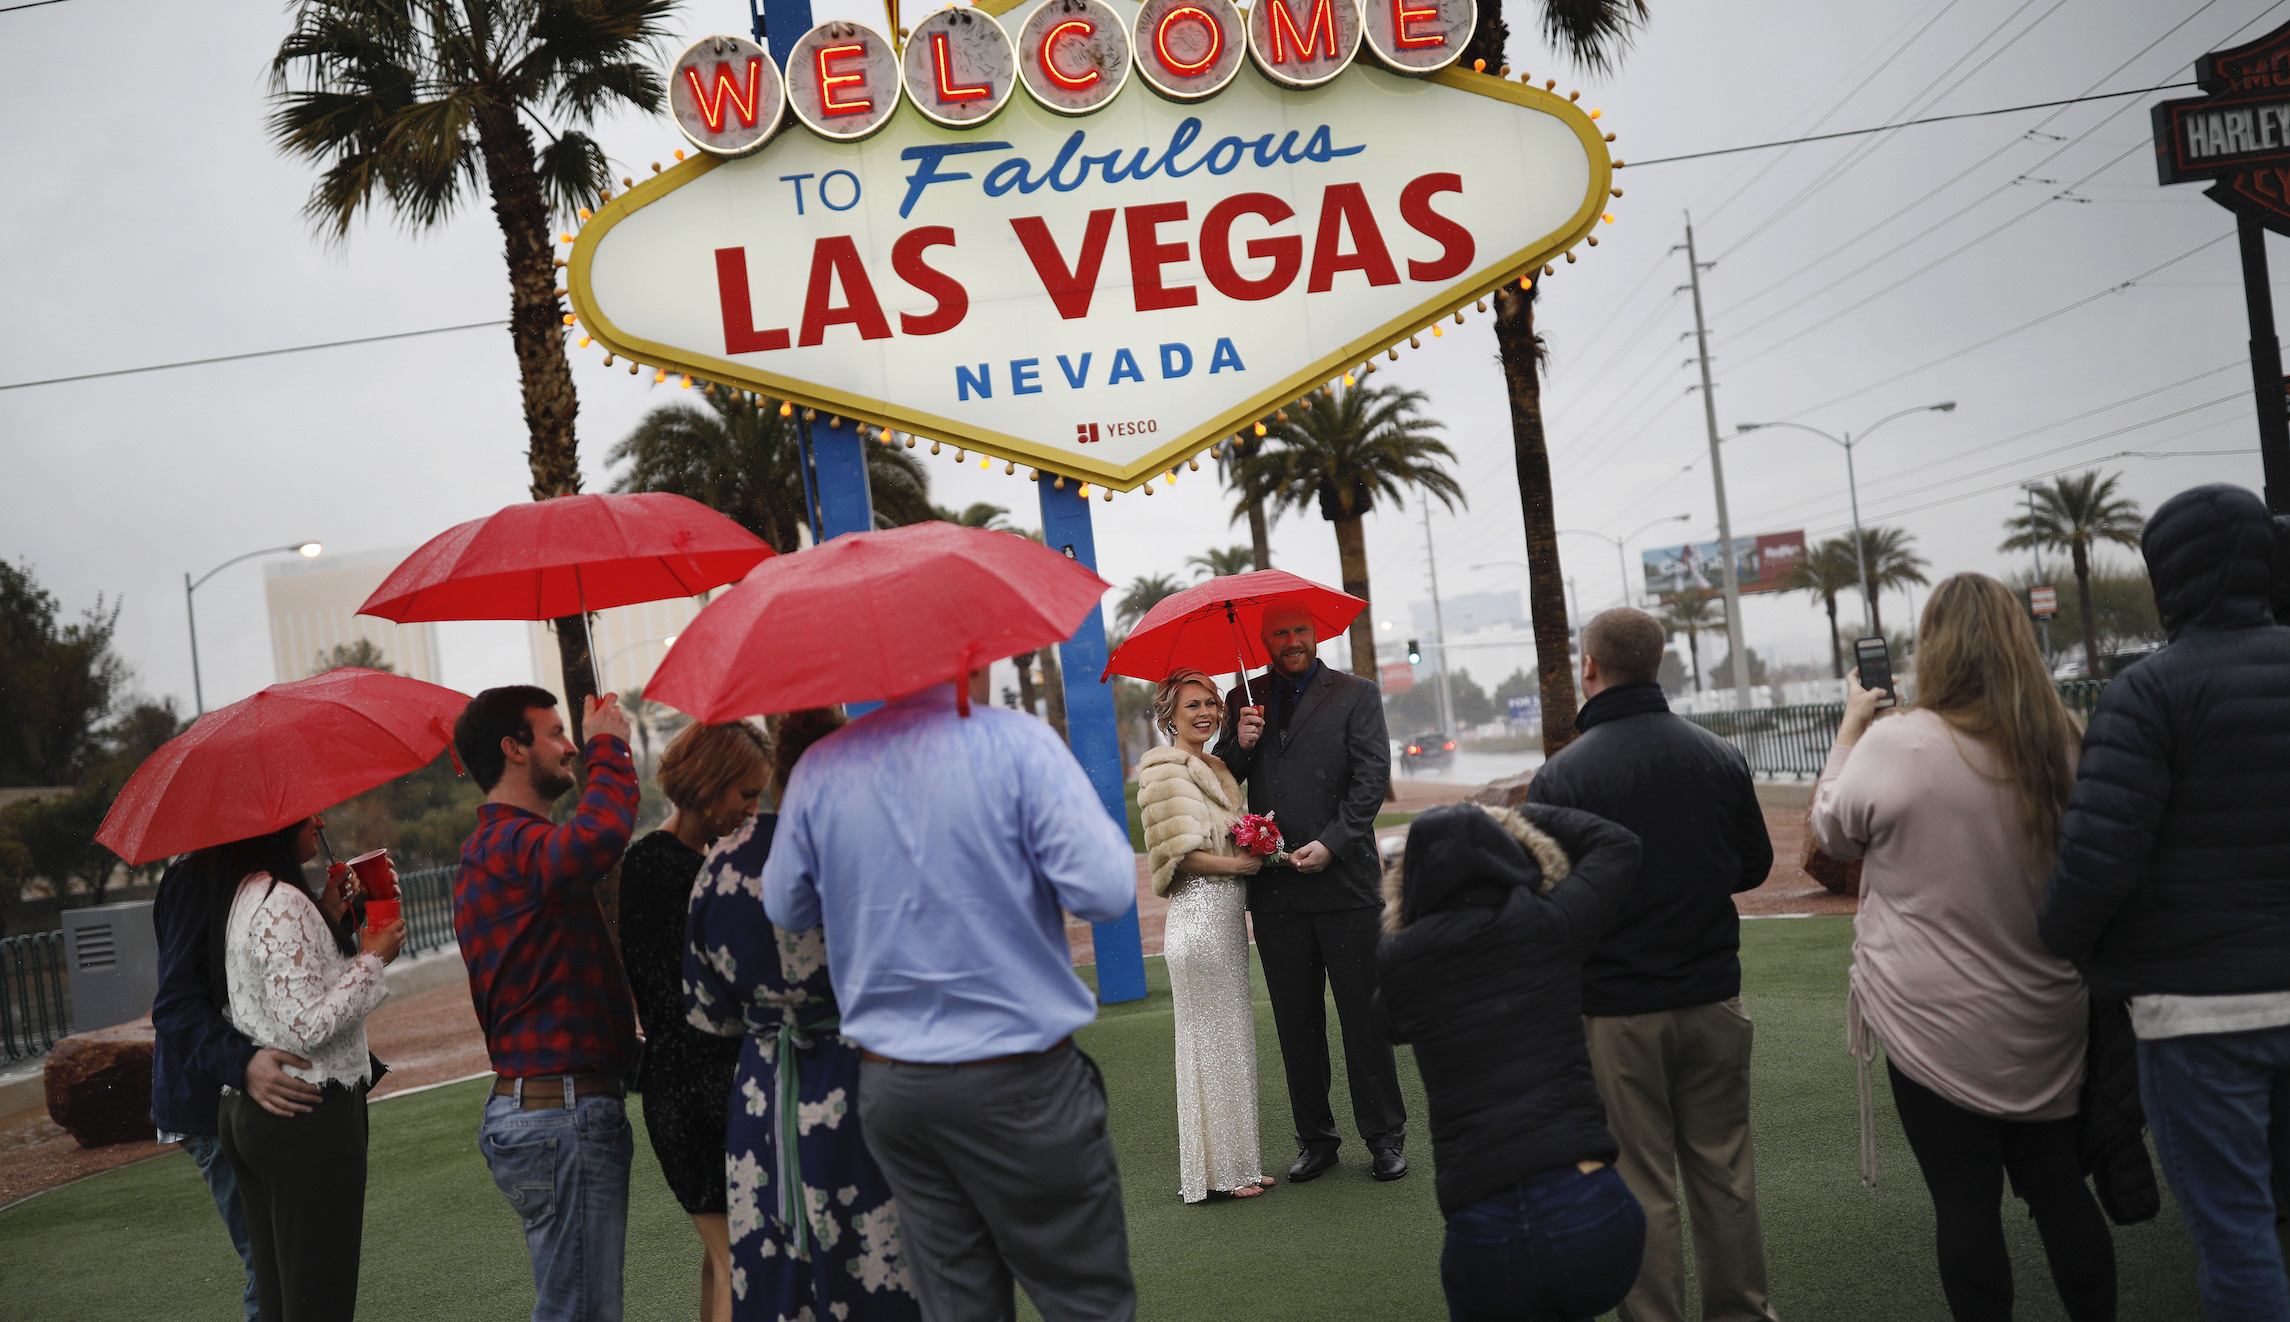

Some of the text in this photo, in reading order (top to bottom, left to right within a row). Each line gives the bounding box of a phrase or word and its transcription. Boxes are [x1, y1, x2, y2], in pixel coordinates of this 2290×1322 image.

[684, 0, 1446, 134] WELCOME
[780, 117, 1366, 220] TO Fabulous
[2186, 104, 2290, 158] HARLEY
[714, 172, 1476, 355] LAS VEGAS
[955, 337, 1246, 402] NEVADA
[1106, 419, 1157, 437] YESCO
